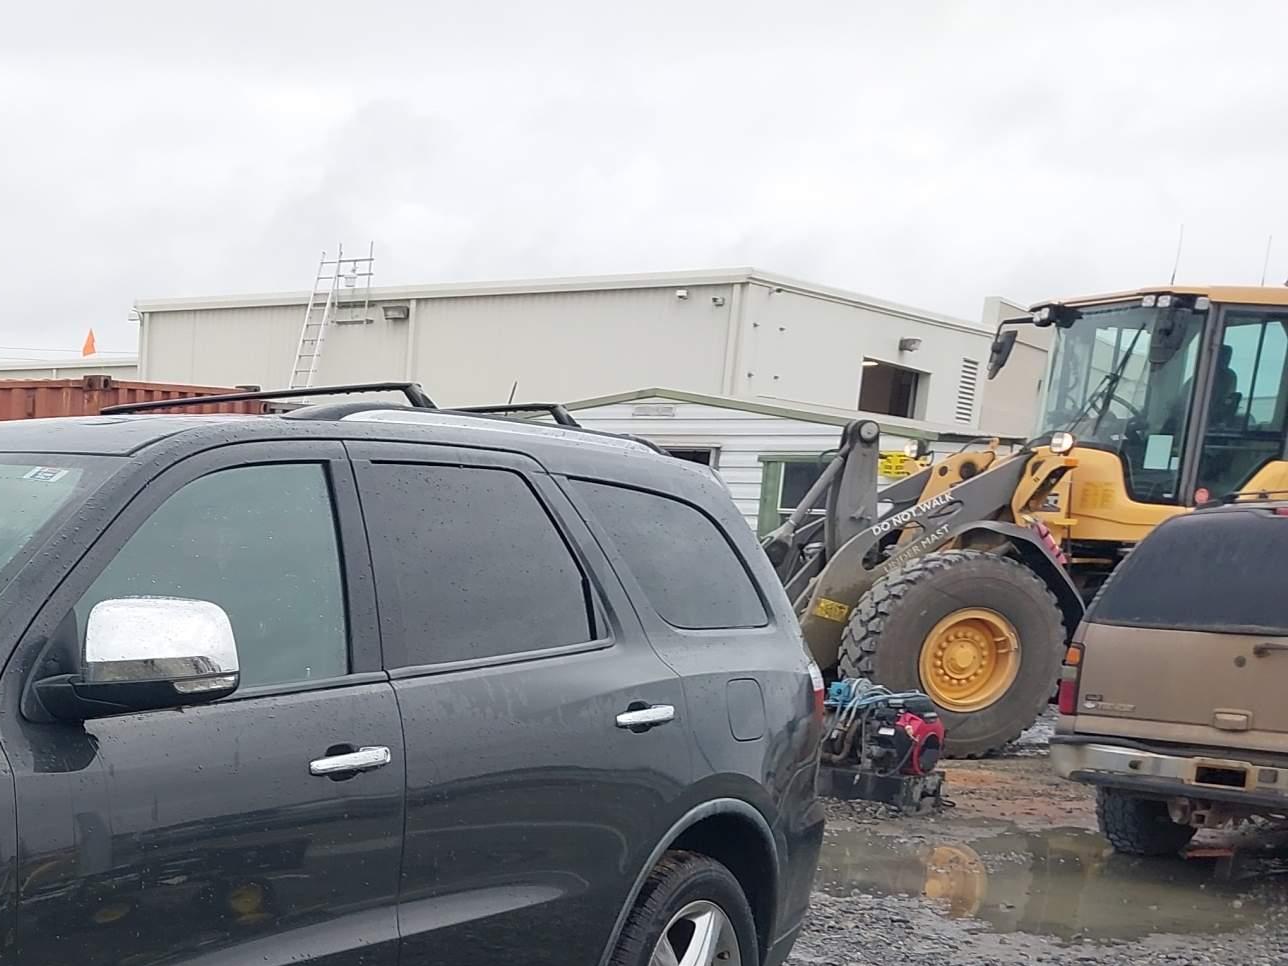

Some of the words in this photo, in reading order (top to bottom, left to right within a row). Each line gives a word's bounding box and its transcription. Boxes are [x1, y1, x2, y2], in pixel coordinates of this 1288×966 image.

[872, 521, 890, 536] DO
[892, 505, 918, 526] NOT
[918, 492, 954, 513] WALK
[920, 524, 951, 548] MAST
